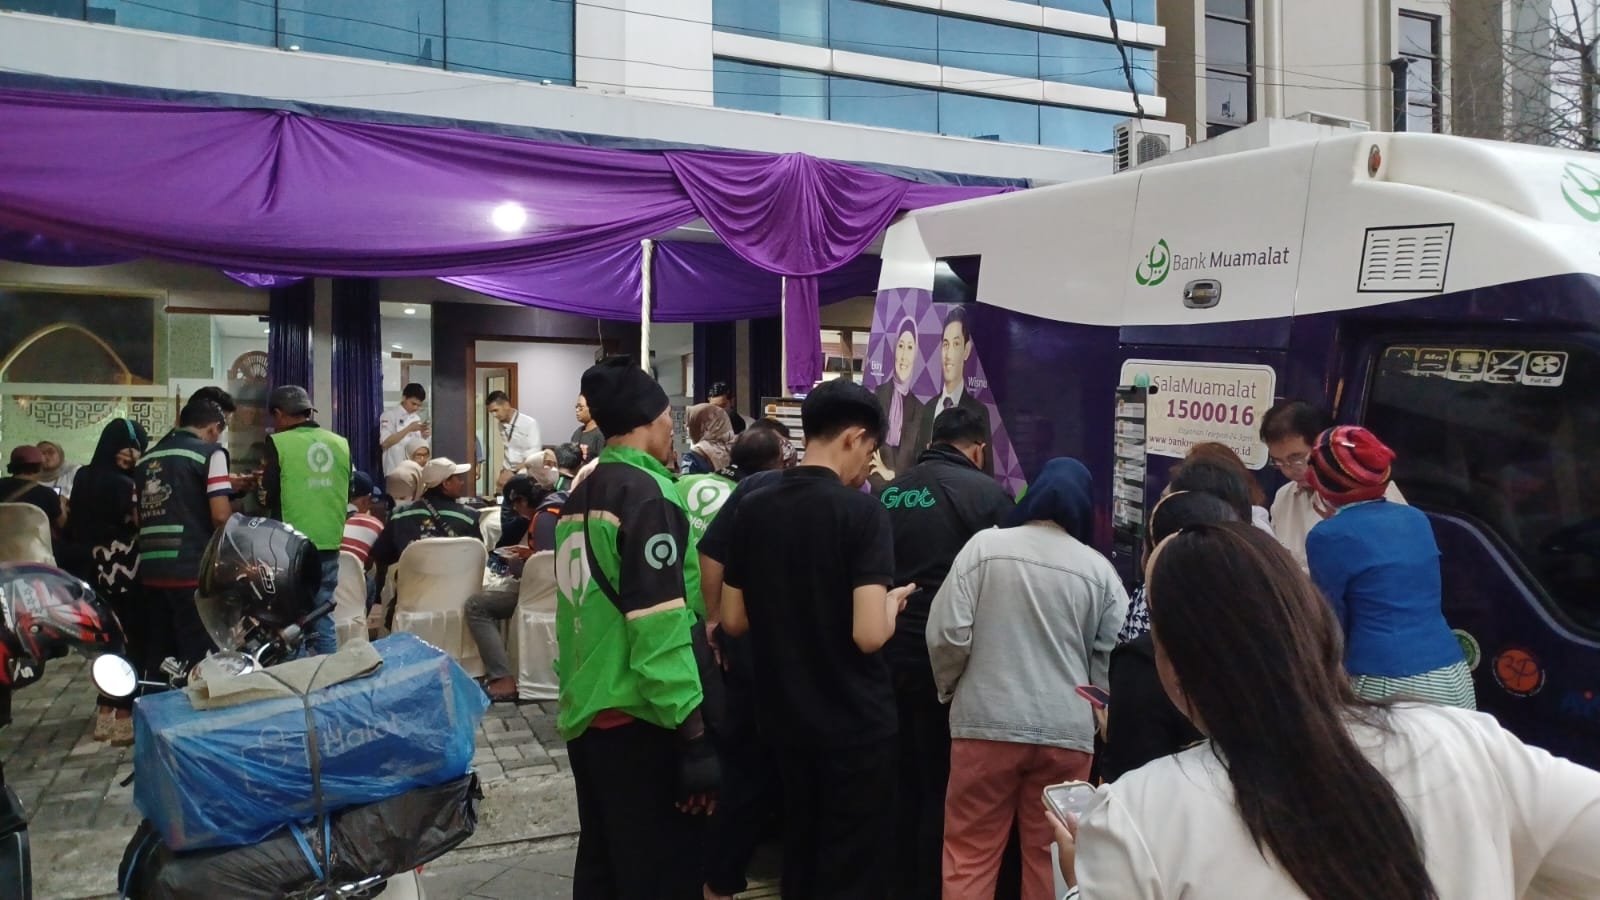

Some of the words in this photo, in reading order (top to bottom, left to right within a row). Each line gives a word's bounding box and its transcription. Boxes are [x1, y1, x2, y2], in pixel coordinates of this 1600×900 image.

[1173, 252, 1206, 271] Bank
[1209, 246, 1290, 268] Muamalat
[1153, 376, 1257, 399] SalaMuamalat
[1167, 399, 1254, 426] 1500016
